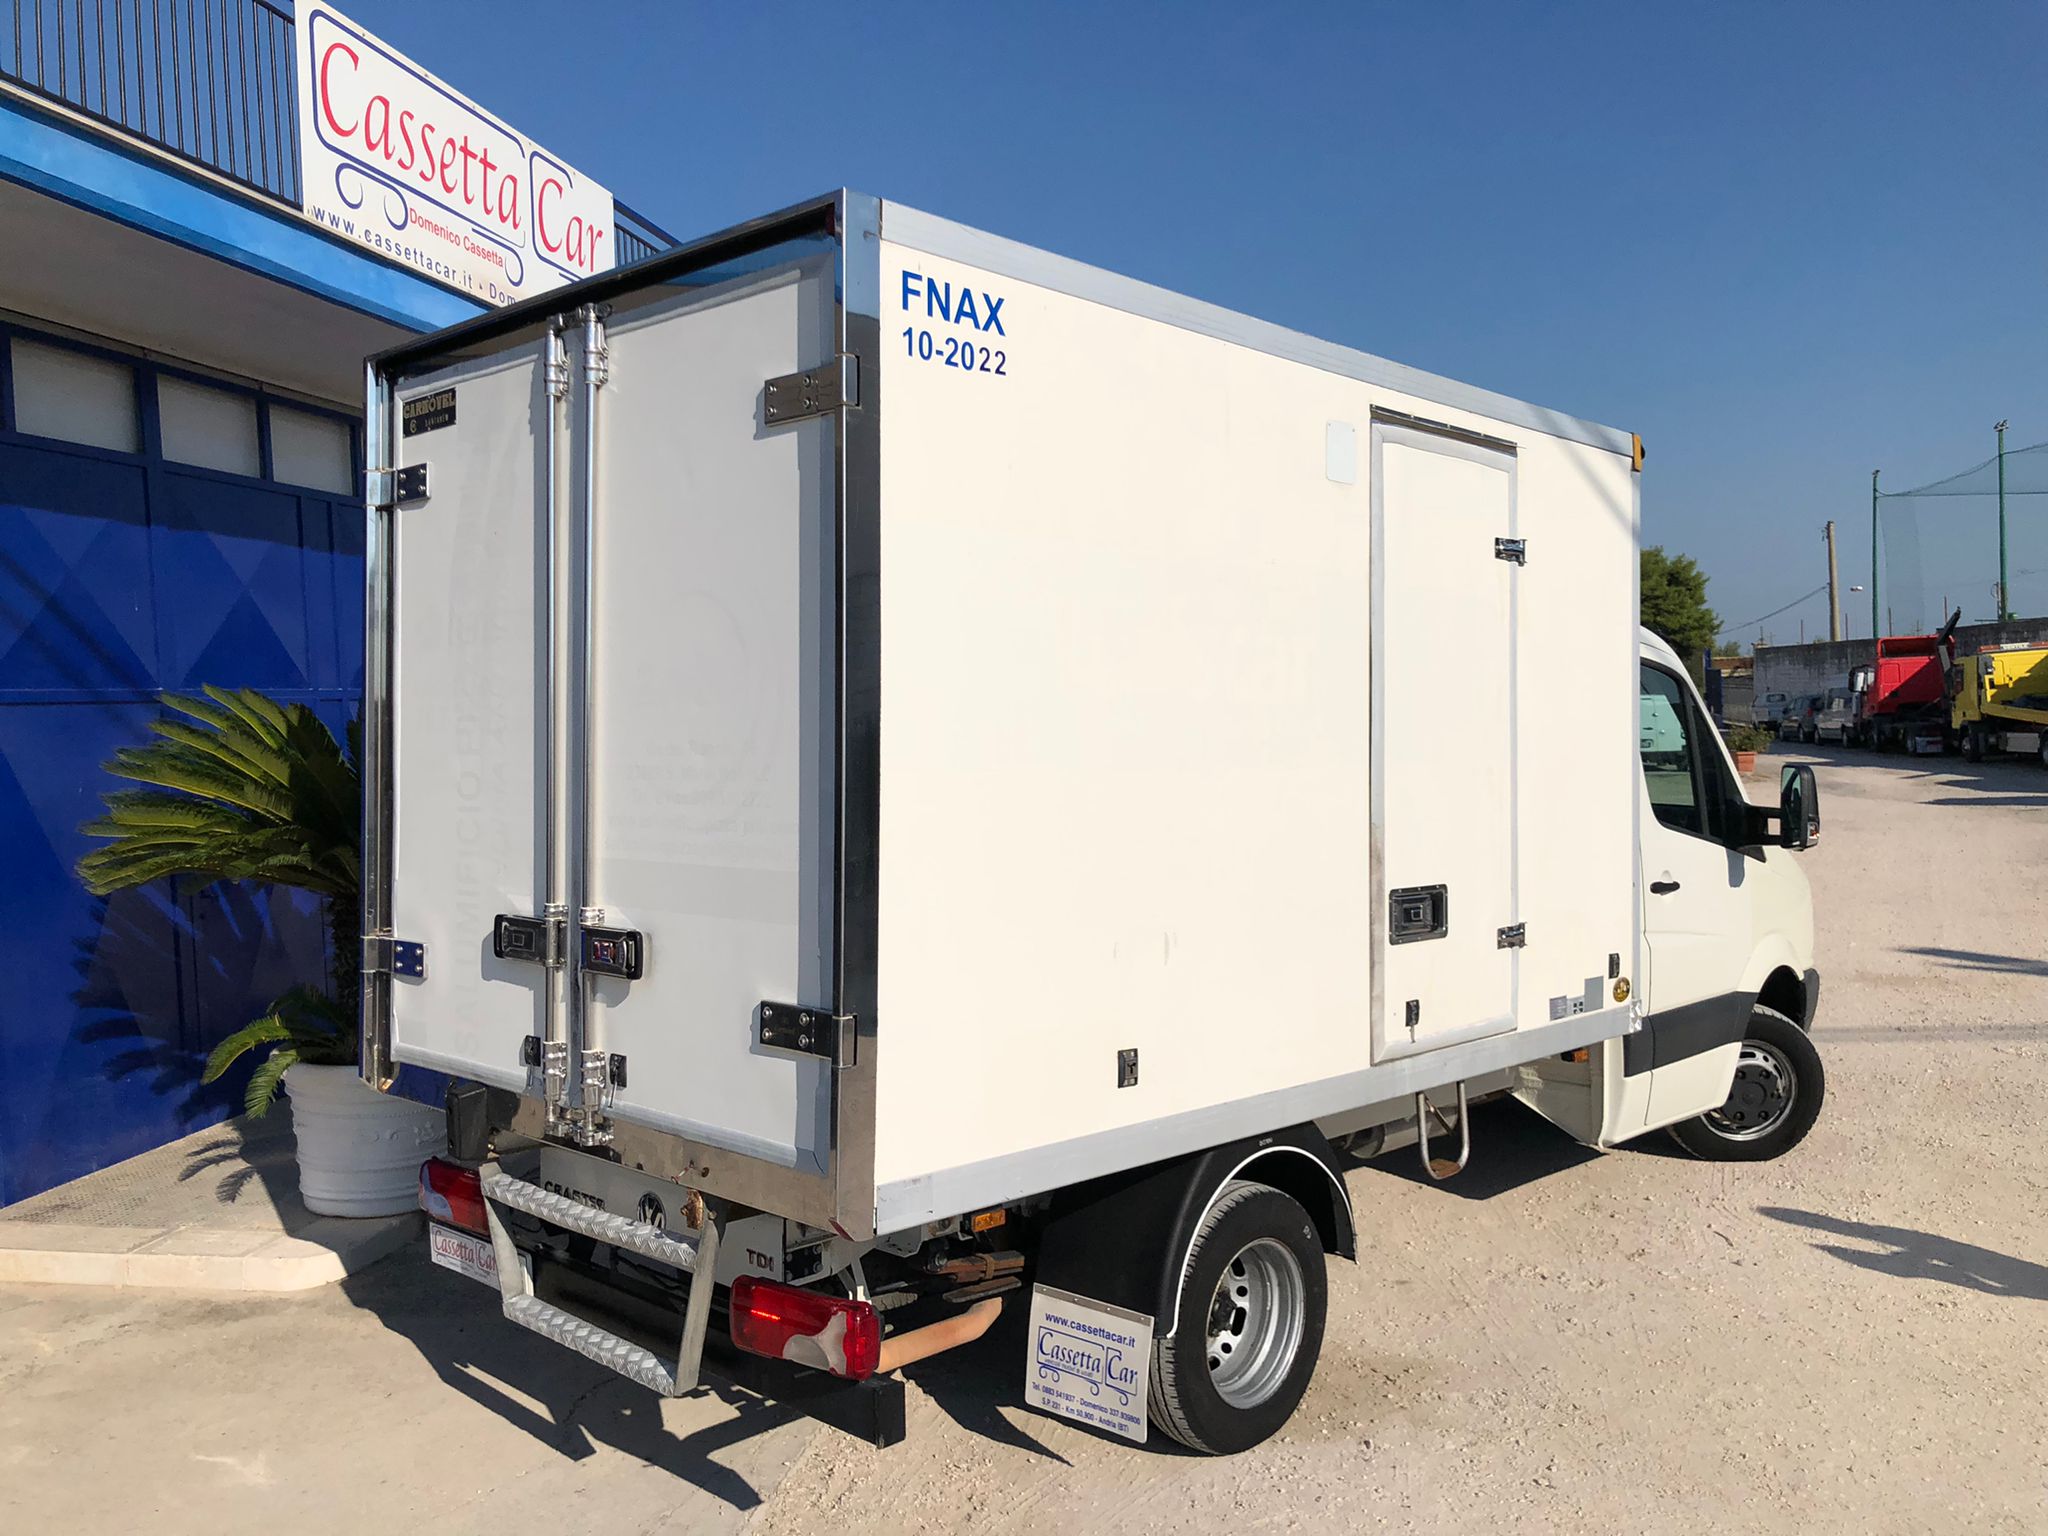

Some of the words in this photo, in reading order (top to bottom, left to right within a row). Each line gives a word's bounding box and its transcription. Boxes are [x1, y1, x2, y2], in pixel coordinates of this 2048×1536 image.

[321, 42, 521, 230] Cassetta
[538, 178, 603, 272] Car
[313, 204, 473, 290] www.cassettacar.it
[409, 207, 460, 247] Domenico
[463, 235, 504, 268] Cassetta
[902, 269, 1006, 337] FNAX
[902, 326, 1007, 376] 10-2022
[434, 1230, 475, 1264] Cassetta
[745, 1248, 775, 1272] TDI
[1045, 1312, 1136, 1348] www.cassettacar.it
[1039, 1331, 1101, 1373] Cassetta
[1107, 1355, 1138, 1385] Car
